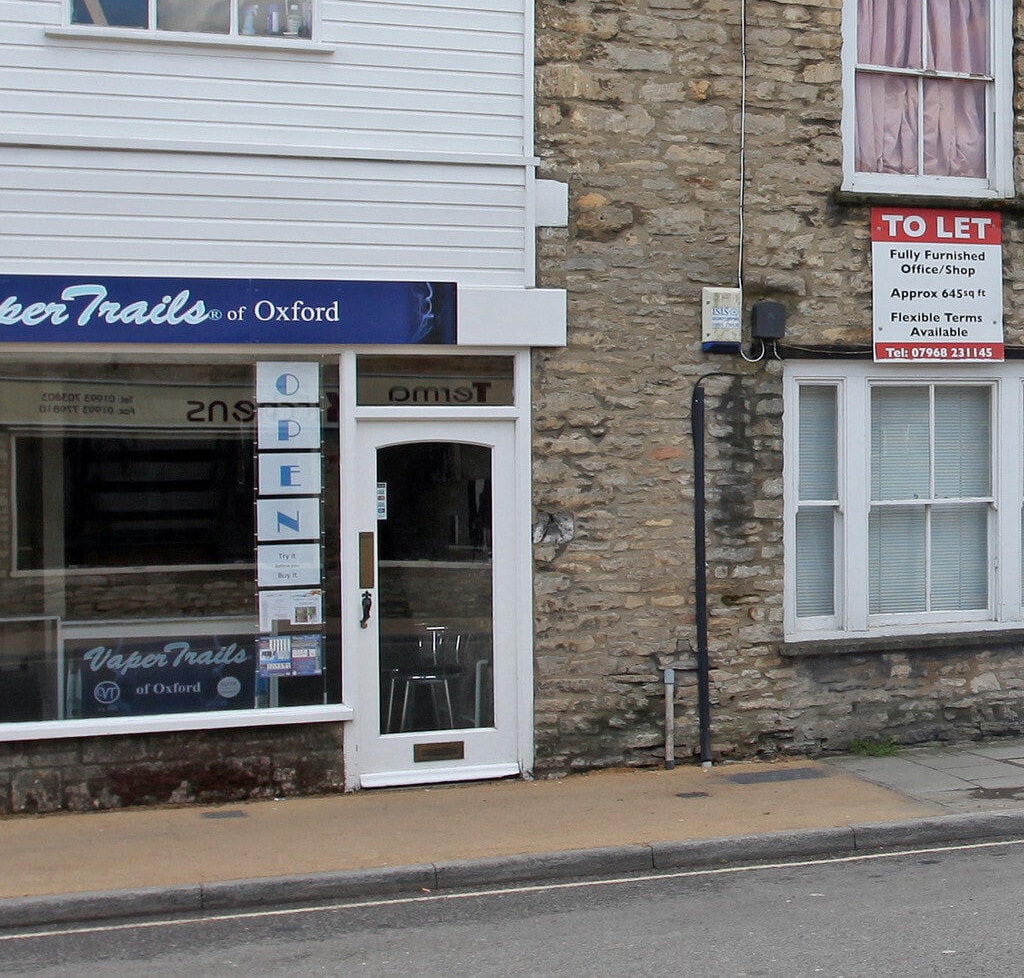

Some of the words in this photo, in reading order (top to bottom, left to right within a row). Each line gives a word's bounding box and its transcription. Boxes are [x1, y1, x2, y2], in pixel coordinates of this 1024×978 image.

[881, 214, 927, 238] TO
[936, 216, 992, 239] LET
[890, 249, 920, 262] Fully
[924, 250, 985, 261] Furnished
[900, 264, 976, 277] Office/Shop
[890, 288, 938, 301] Approx
[977, 288, 986, 297] ft
[227, 306, 247, 321] of
[254, 300, 340, 322] Oxford
[890, 312, 941, 323] Flexible
[943, 312, 983, 323] Terms
[910, 327, 968, 337] Available
[885, 347, 908, 358] Tel:
[911, 347, 948, 358] 07968
[950, 347, 993, 358] 231145
[136, 683, 150, 695] of
[153, 682, 201, 695] Oxford
